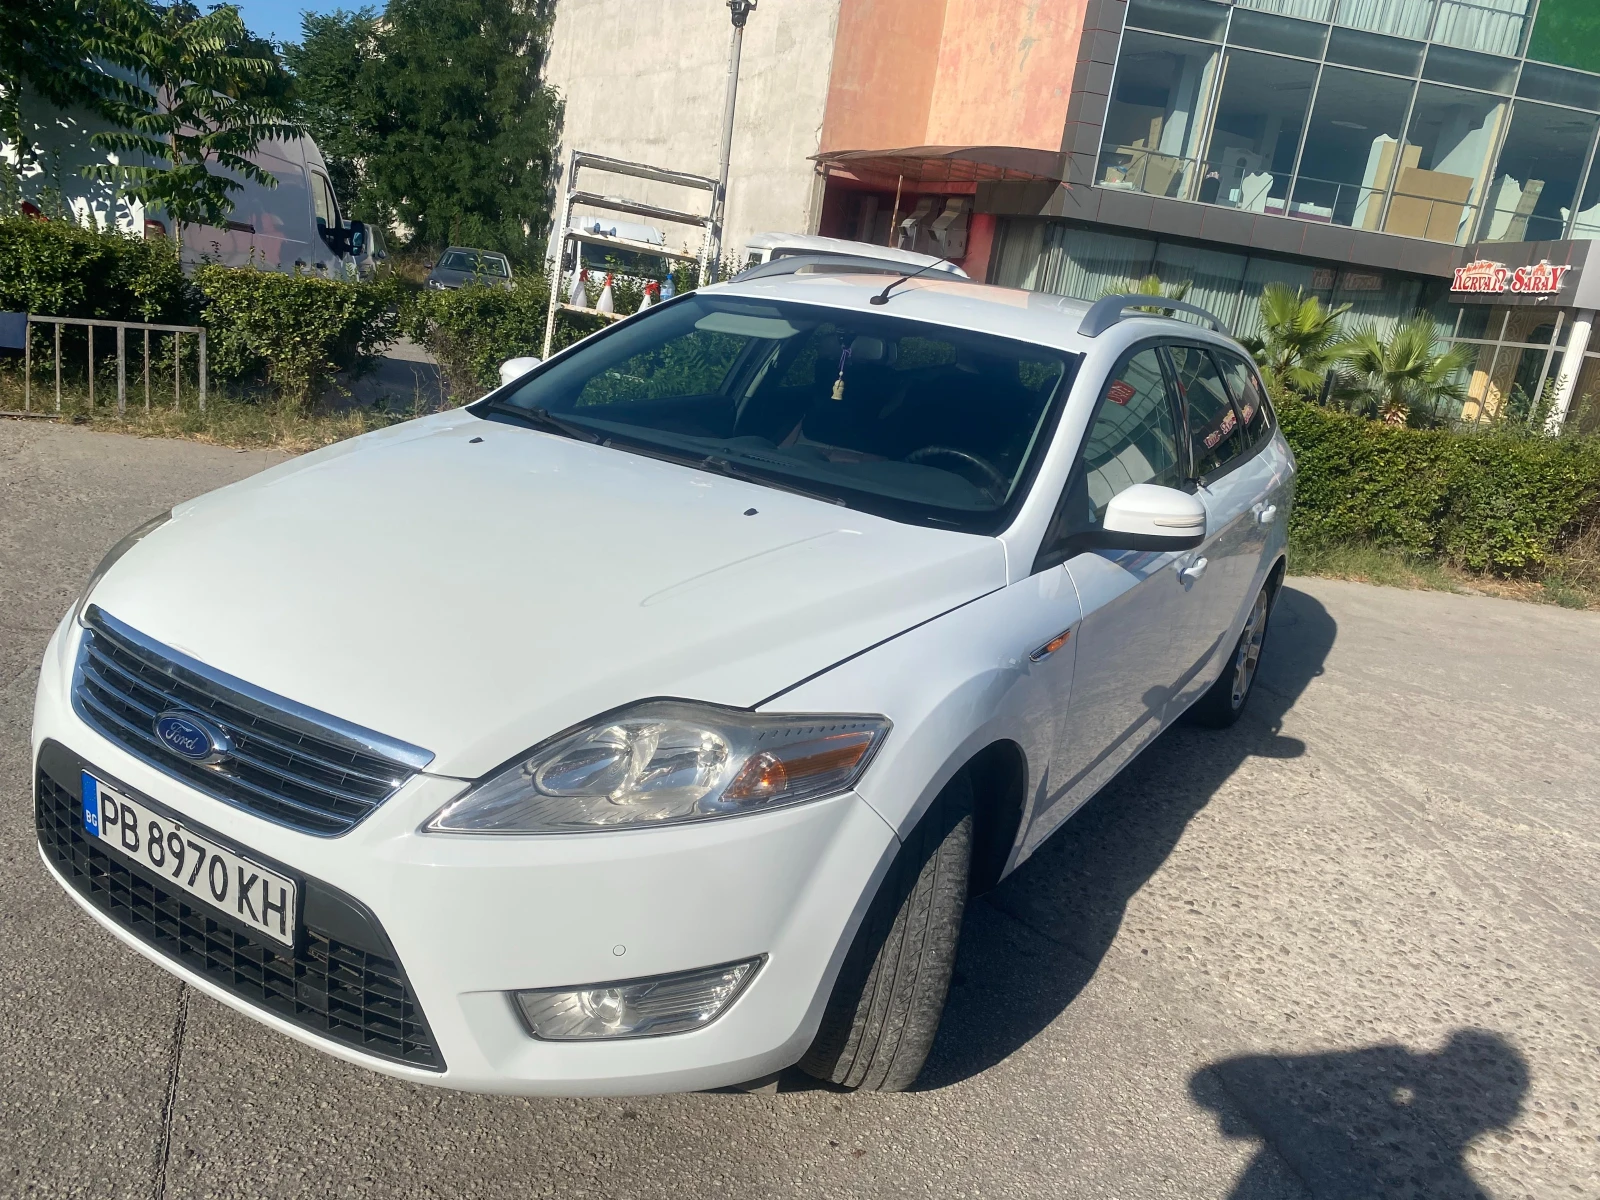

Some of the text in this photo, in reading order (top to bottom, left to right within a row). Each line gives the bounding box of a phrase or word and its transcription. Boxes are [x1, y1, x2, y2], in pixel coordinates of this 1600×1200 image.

[1511, 266, 1566, 292] SARAY
[165, 721, 199, 750] Ford
[85, 809, 98, 827] BG
[100, 791, 287, 937] PB 8970 KH
